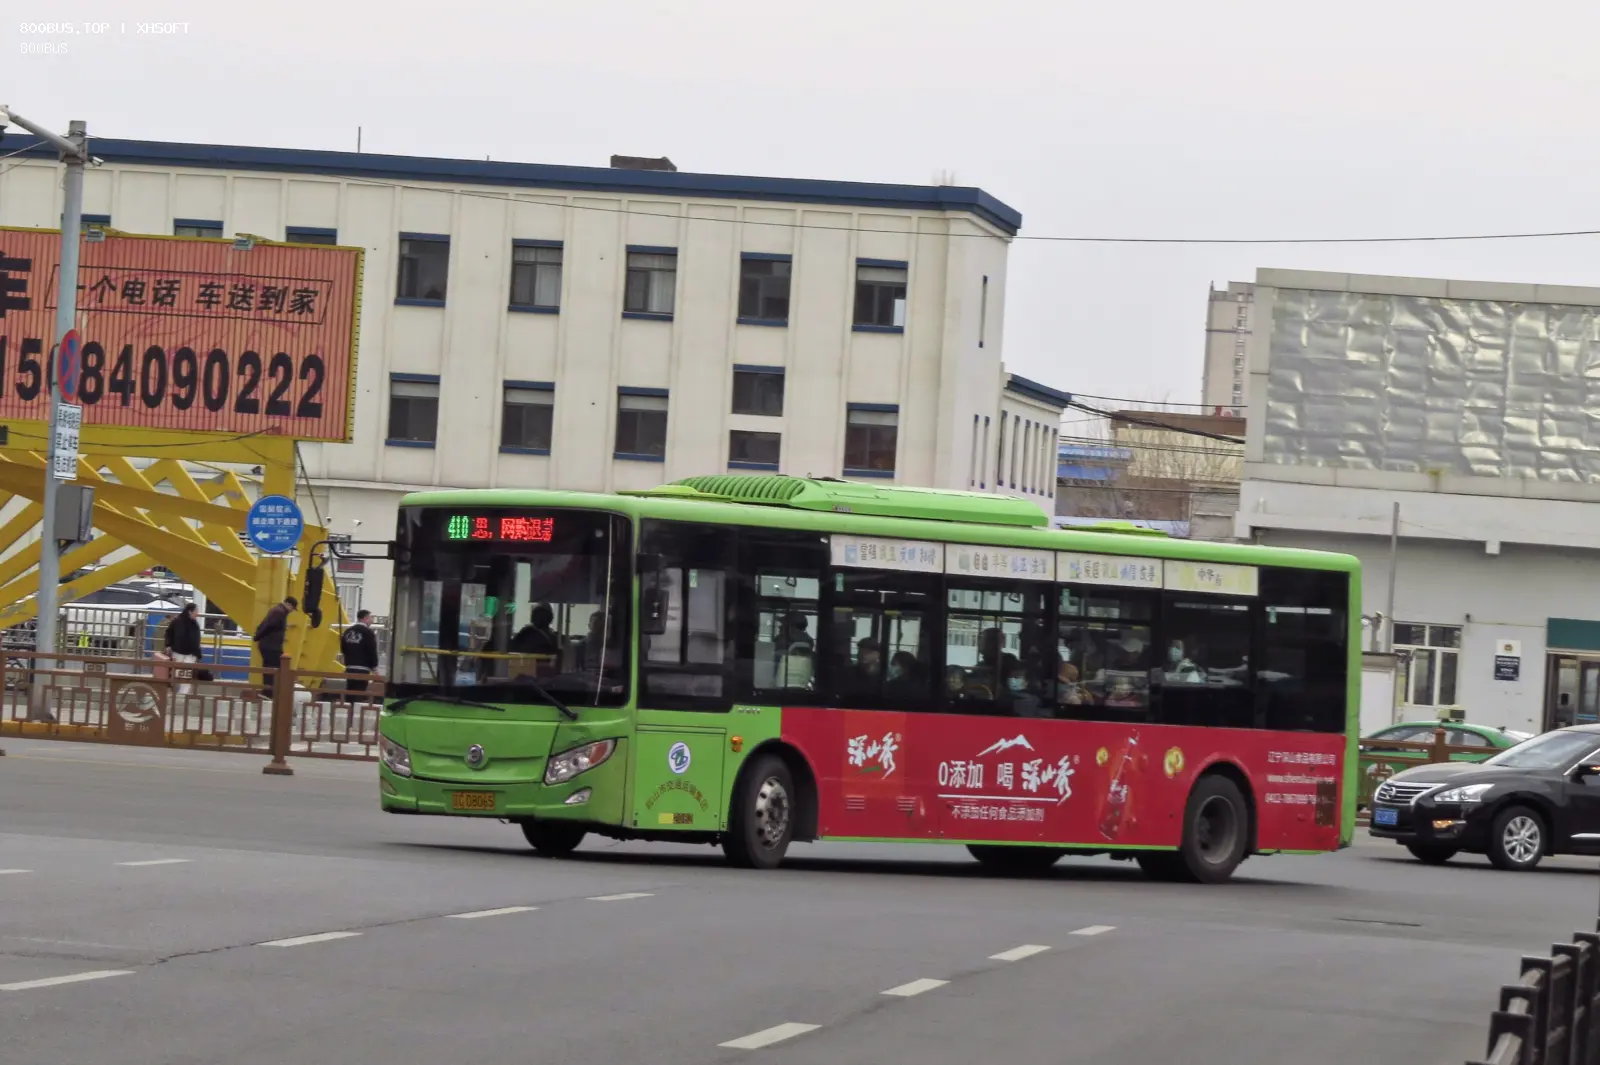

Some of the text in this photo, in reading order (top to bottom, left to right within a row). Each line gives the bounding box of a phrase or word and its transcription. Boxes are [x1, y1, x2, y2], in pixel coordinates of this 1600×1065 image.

[195, 281, 320, 316] 车送到家
[0, 335, 326, 419] 1584090222
[938, 759, 984, 789] 0添加
[997, 762, 1014, 790] 喝
